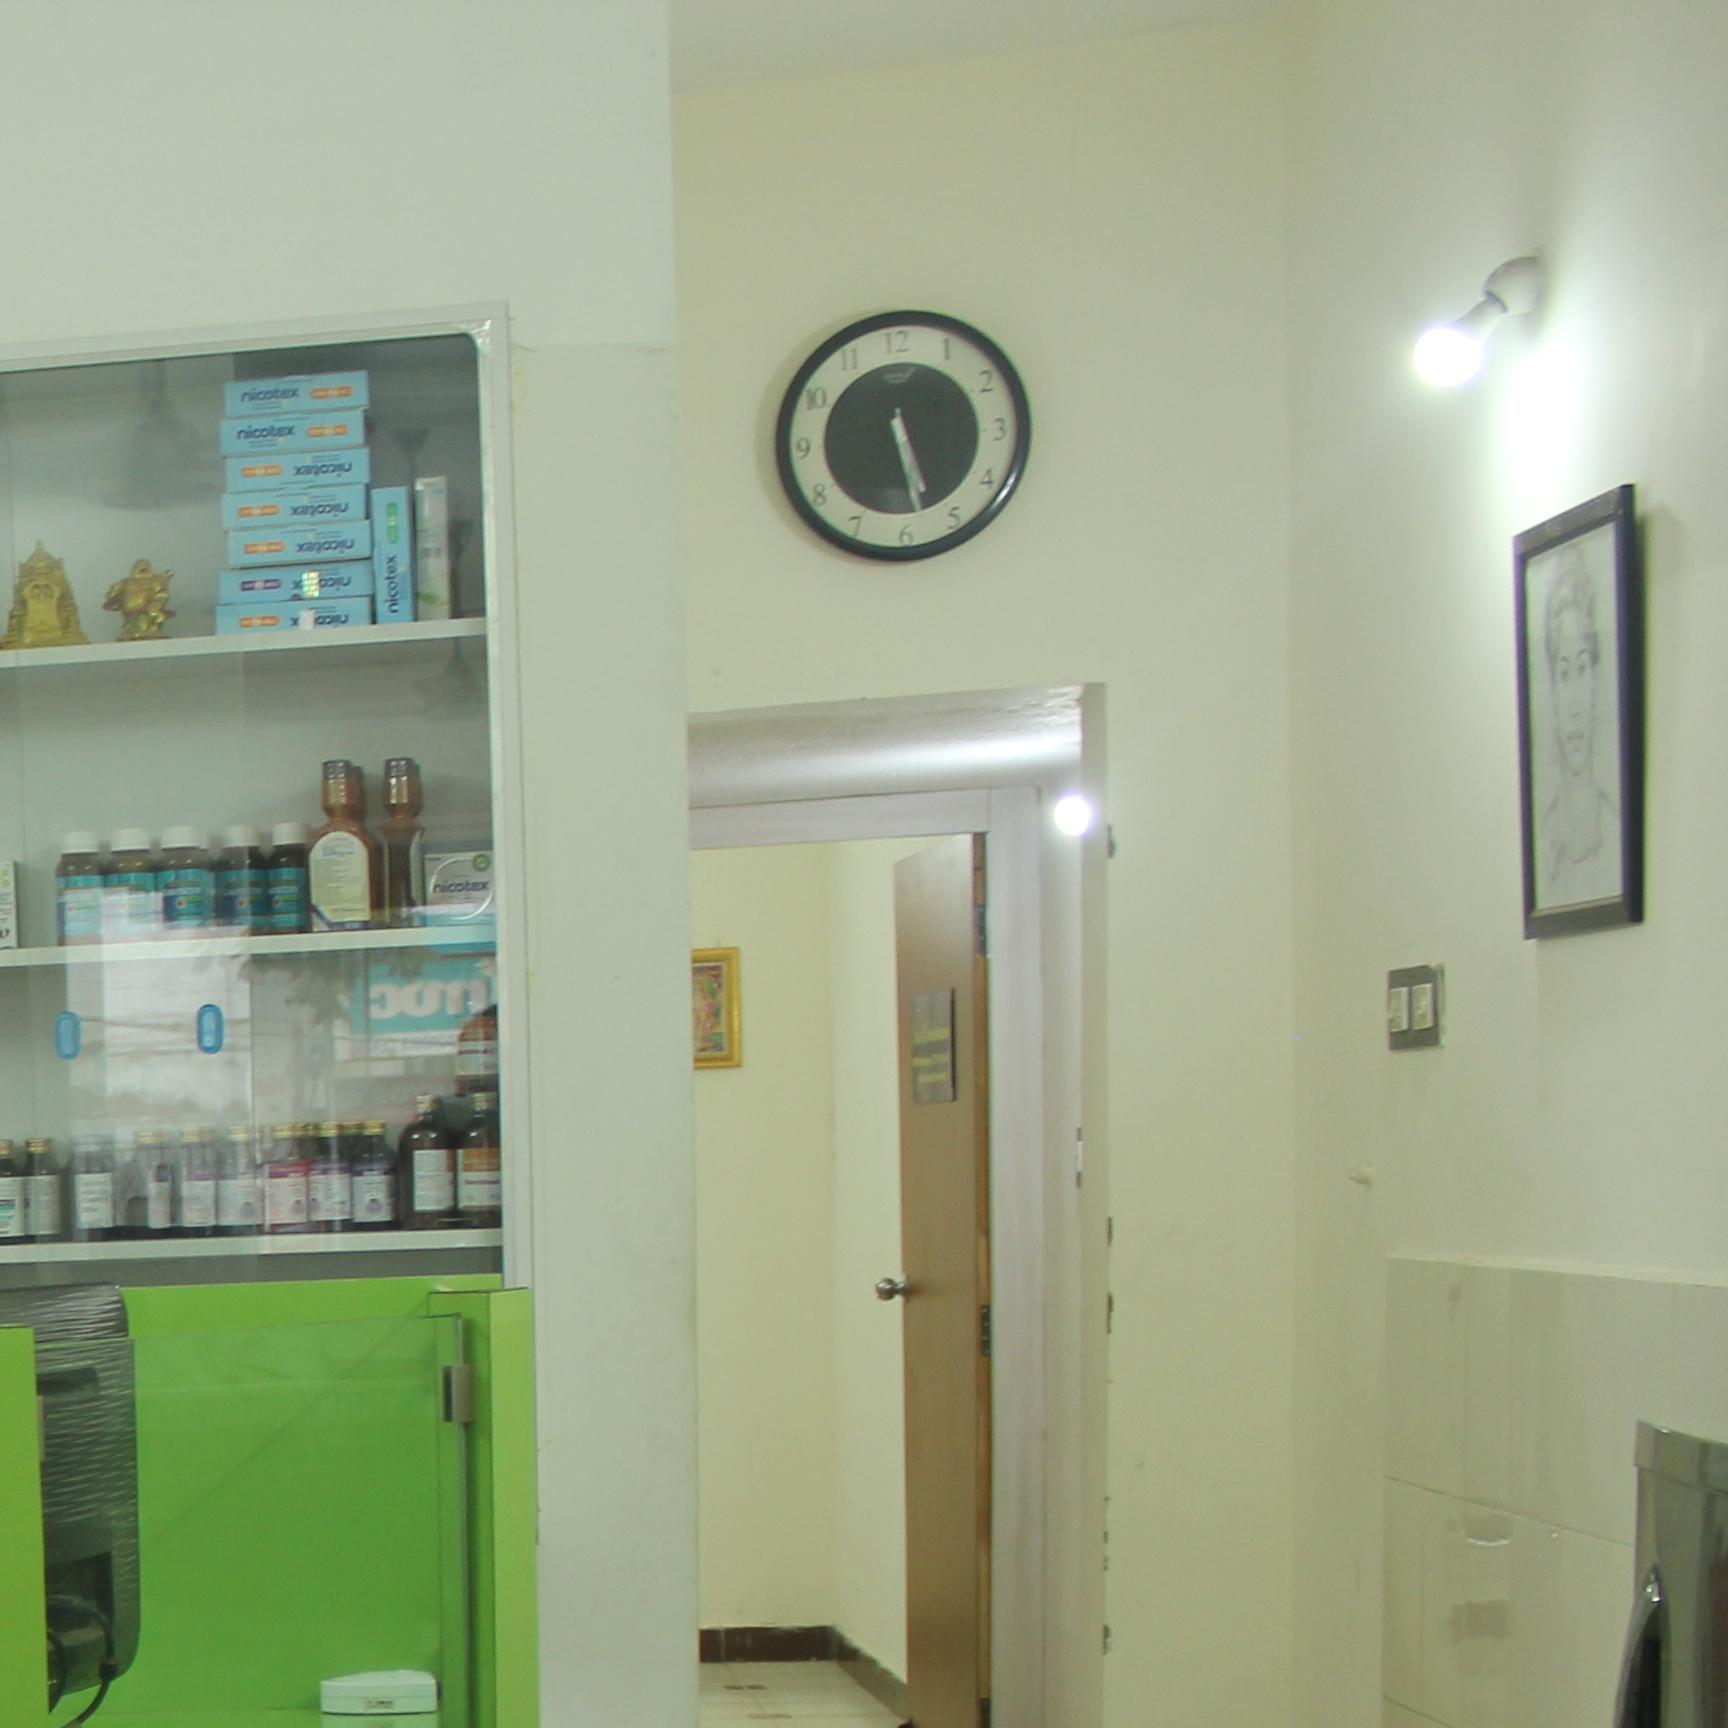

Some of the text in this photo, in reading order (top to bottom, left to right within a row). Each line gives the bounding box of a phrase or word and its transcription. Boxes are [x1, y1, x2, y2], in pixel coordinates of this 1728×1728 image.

[884, 330, 909, 353] 12
[943, 338, 951, 360] 1
[841, 348, 858, 371] 11
[979, 370, 993, 393] 2
[241, 386, 299, 402] nicotex
[806, 387, 827, 411] 10
[236, 425, 295, 440] nicotex
[994, 418, 1006, 441] 3
[797, 437, 811, 459] 9
[294, 463, 352, 477] nicotex
[979, 468, 994, 489] 4
[813, 484, 827, 506] 8
[291, 502, 349, 517] nicotex
[947, 507, 961, 529] 5
[848, 516, 862, 538] 7
[900, 524, 913, 547] 6
[297, 538, 355, 554] nicotex
[291, 576, 351, 591] nicox
[386, 554, 399, 614] nicotex
[290, 613, 349, 627] nicox
[432, 881, 489, 893] nicotex
